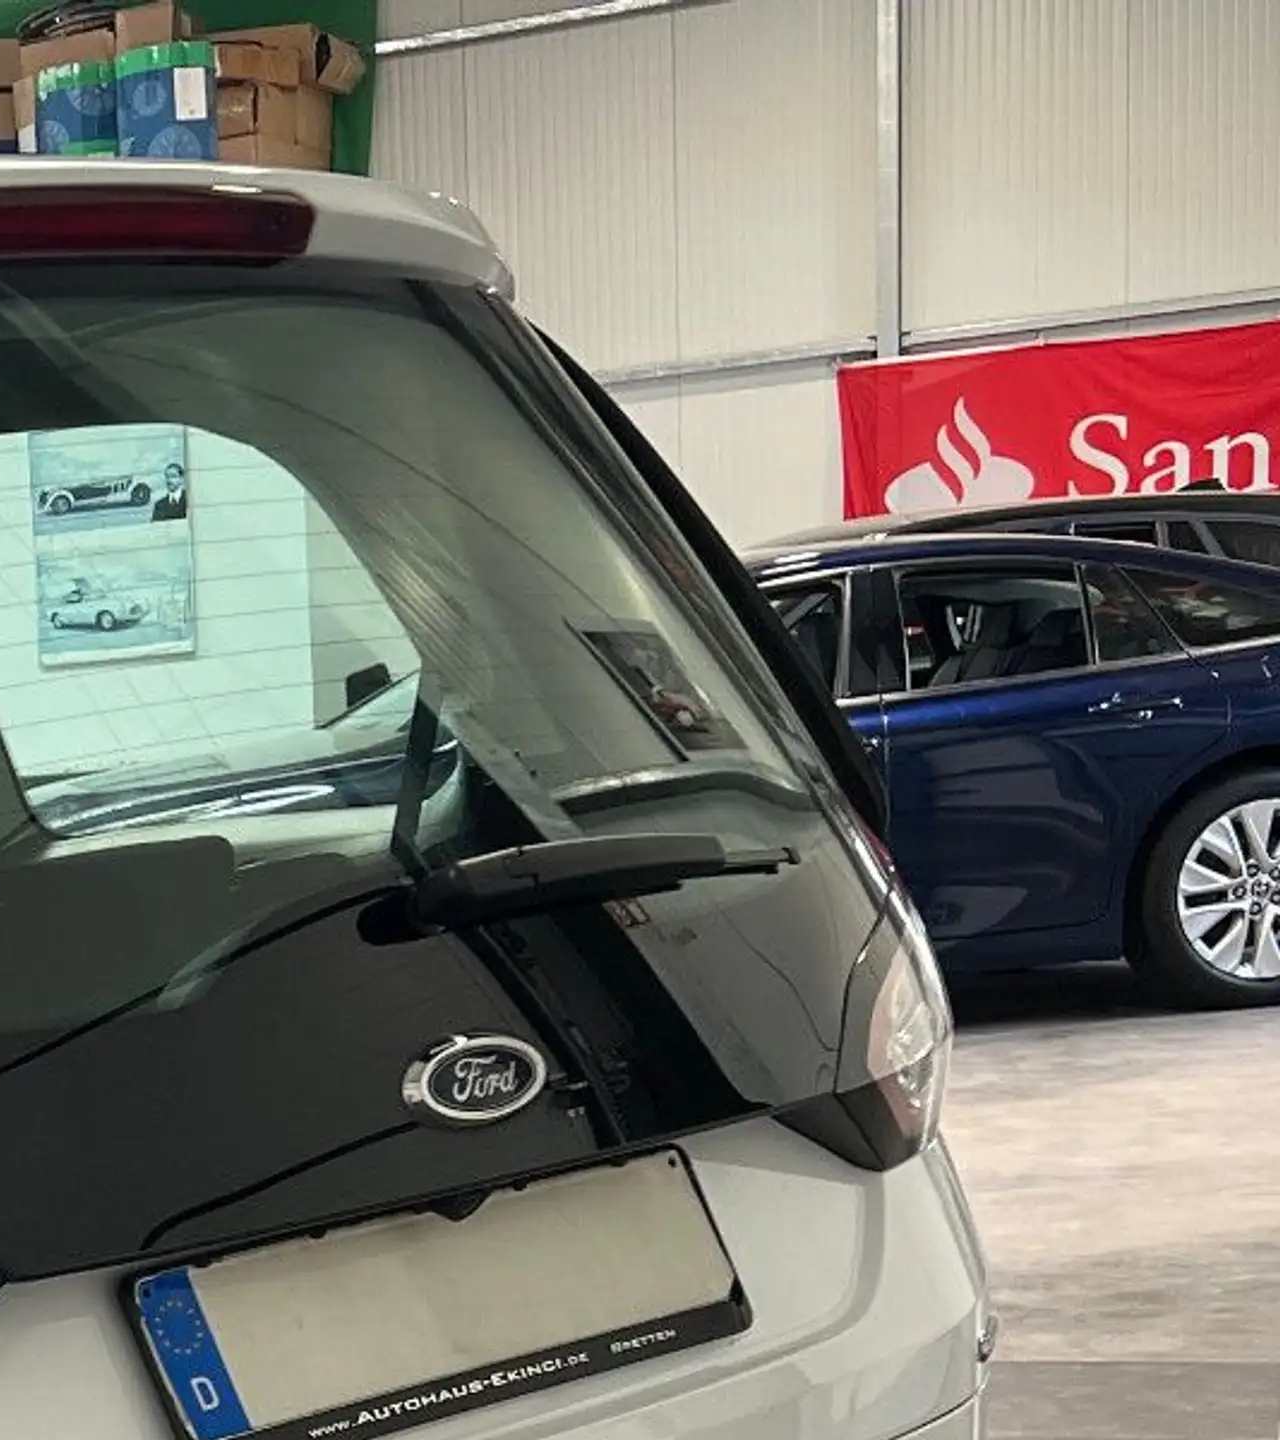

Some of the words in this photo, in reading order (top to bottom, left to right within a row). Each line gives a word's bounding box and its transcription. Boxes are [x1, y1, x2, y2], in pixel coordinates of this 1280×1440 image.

[1067, 413, 1279, 497] San
[452, 1055, 518, 1102] Ford
[191, 1376, 221, 1412] D
